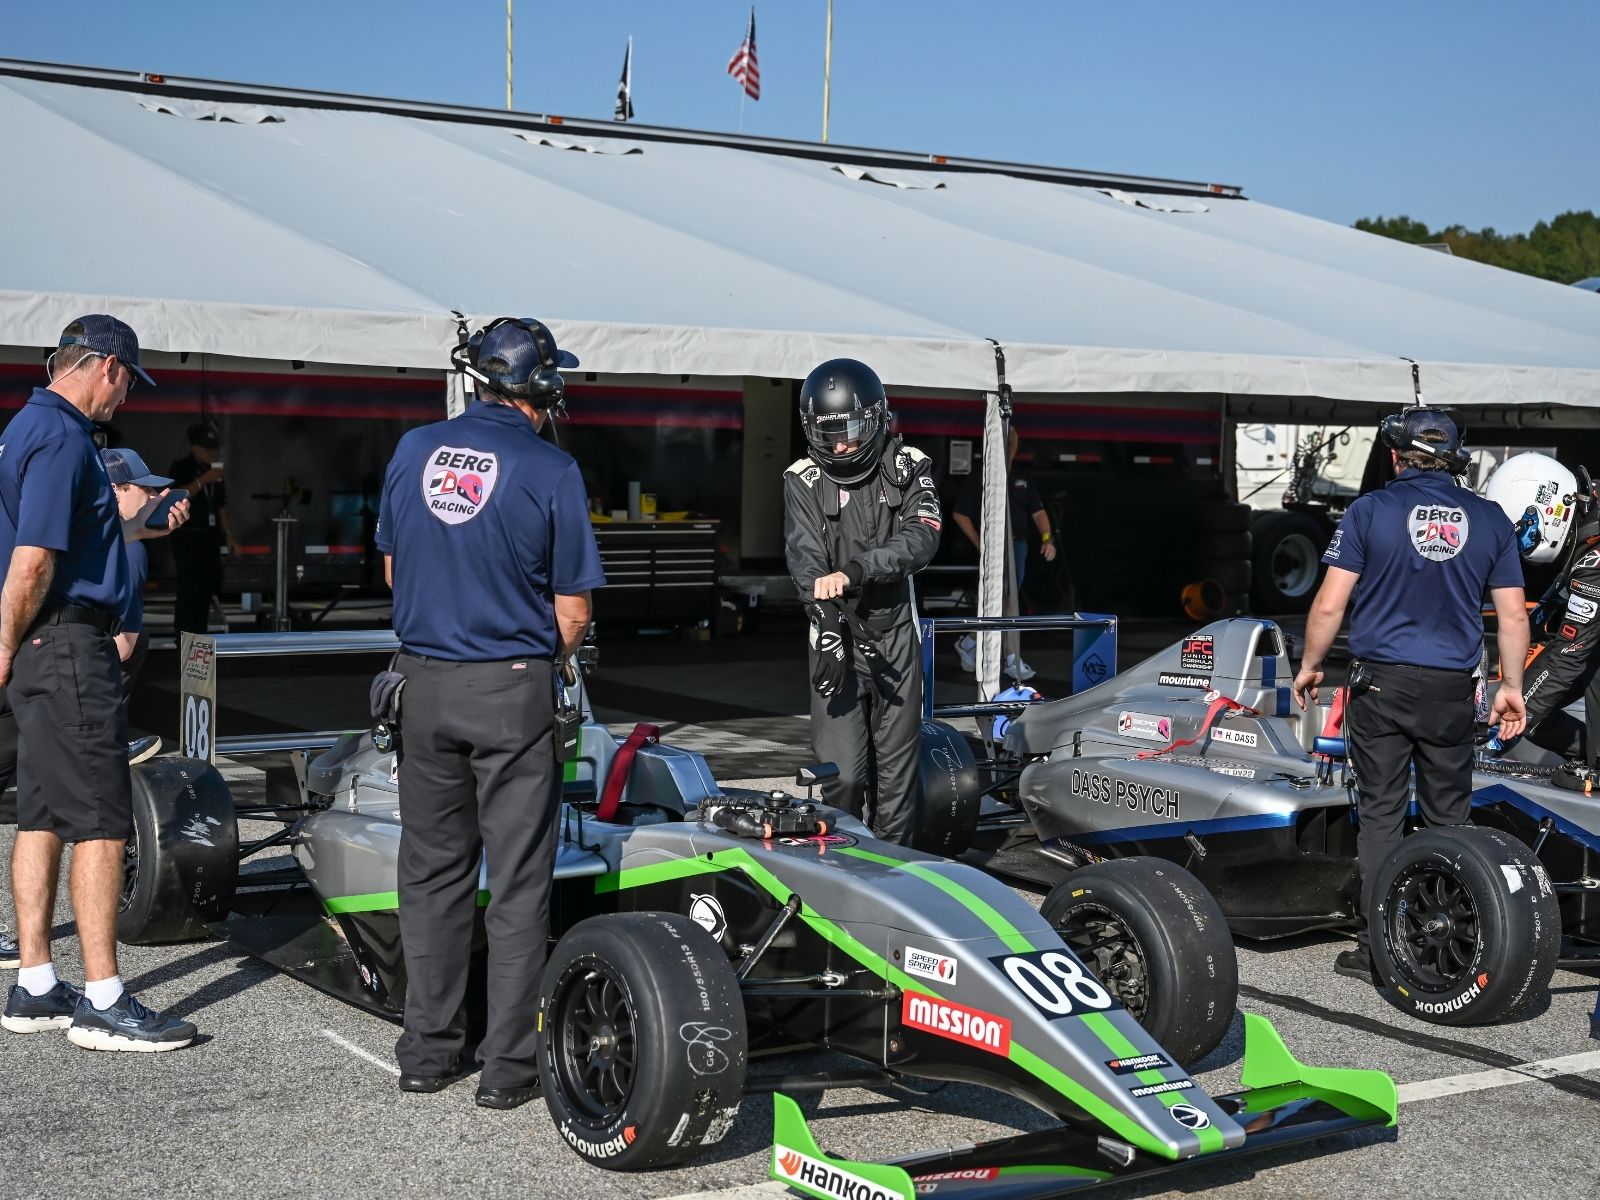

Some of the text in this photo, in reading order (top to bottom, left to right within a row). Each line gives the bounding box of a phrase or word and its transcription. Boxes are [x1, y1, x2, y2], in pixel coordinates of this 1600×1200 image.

[434, 451, 494, 473] BERG
[431, 500, 476, 515] RACING
[1416, 509, 1463, 523] BERG
[1420, 544, 1456, 555] RACING
[1182, 641, 1213, 655] JFC
[188, 649, 213, 664] JFC
[1160, 675, 1210, 688] mountune
[186, 695, 209, 760] 08
[1225, 732, 1255, 745] H. DASS
[1072, 768, 1180, 819] DASS PSYCH
[911, 952, 938, 965] SPEED
[908, 960, 936, 972] SPORT
[1003, 952, 1112, 1015] 08
[1131, 1080, 1193, 1097] mountune
